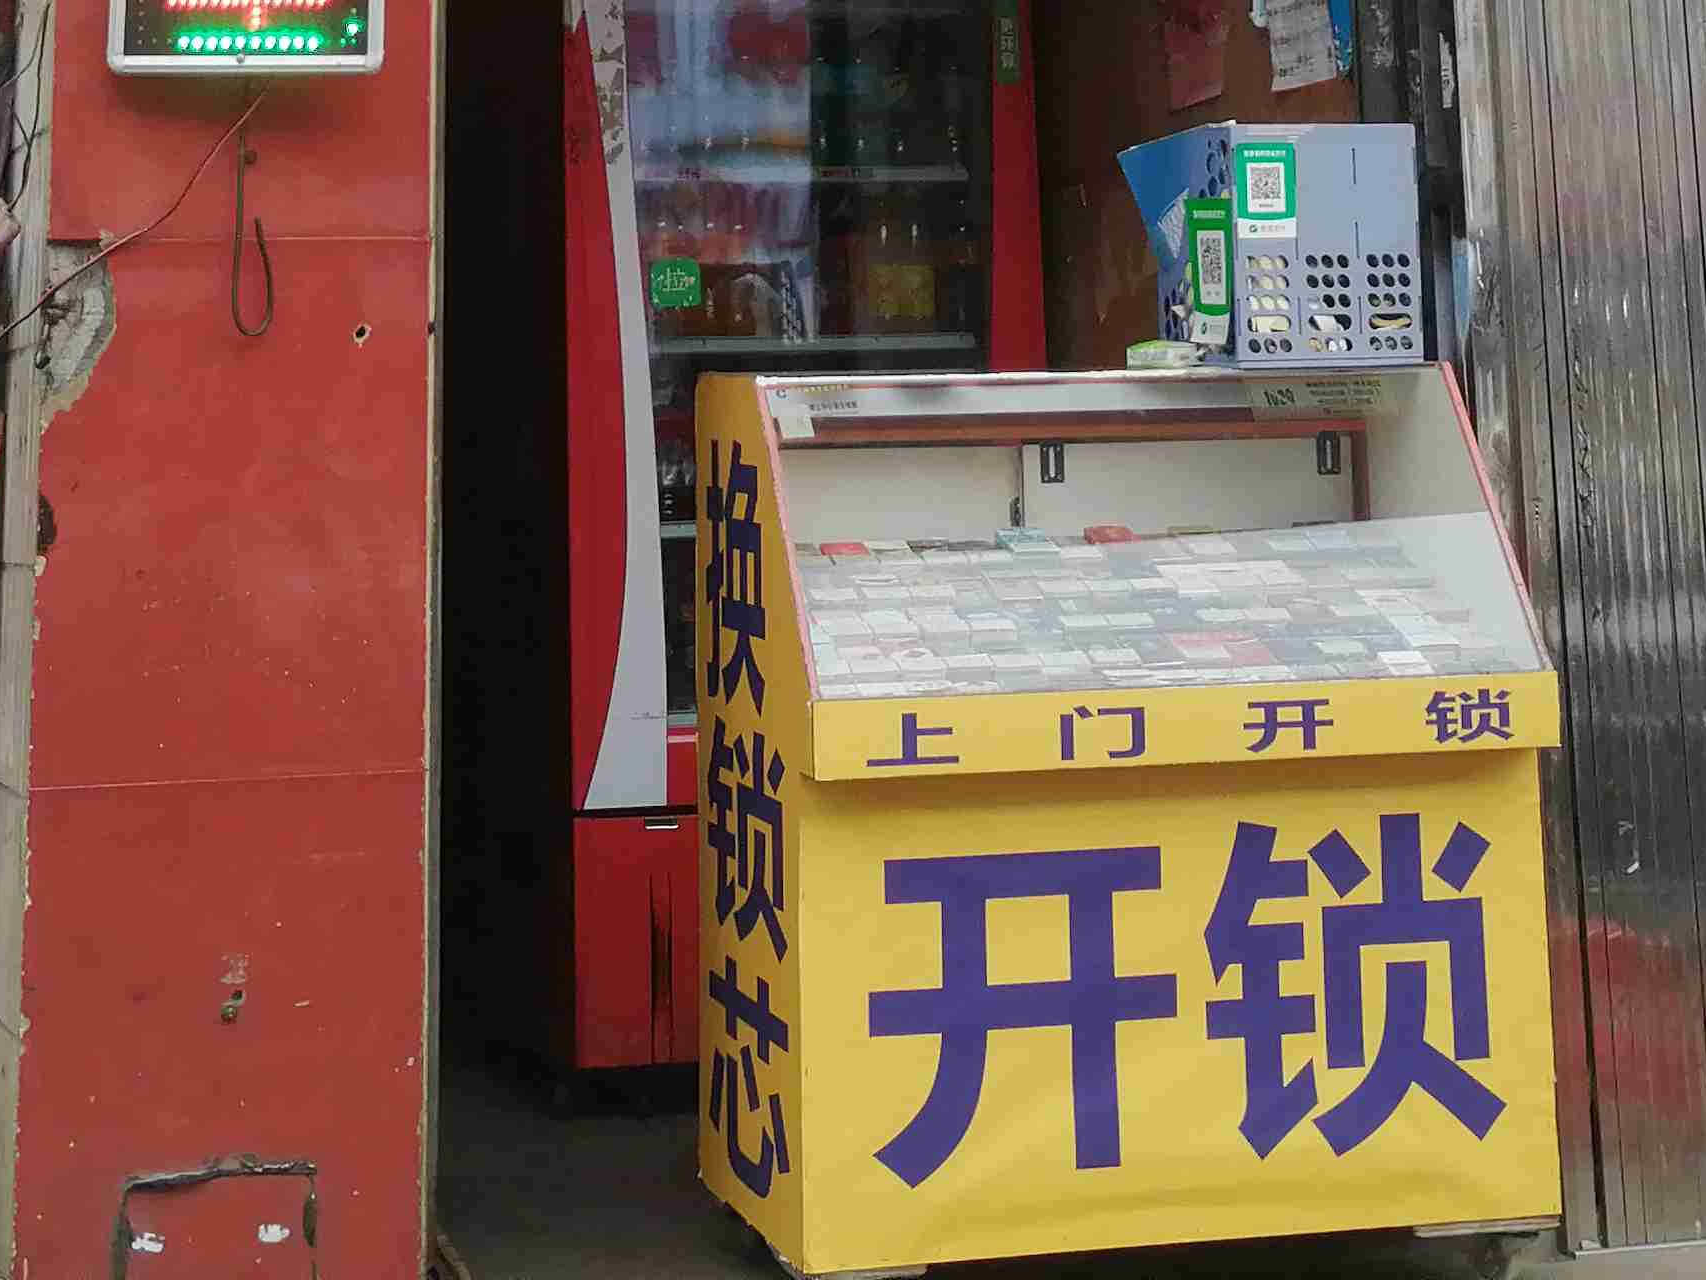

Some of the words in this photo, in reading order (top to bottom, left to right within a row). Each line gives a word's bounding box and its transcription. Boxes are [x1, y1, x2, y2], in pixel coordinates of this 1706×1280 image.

[703, 440, 790, 1202] 换锁芯
[866, 689, 1517, 767] 上门开锁
[868, 813, 1507, 1190] 开锁
